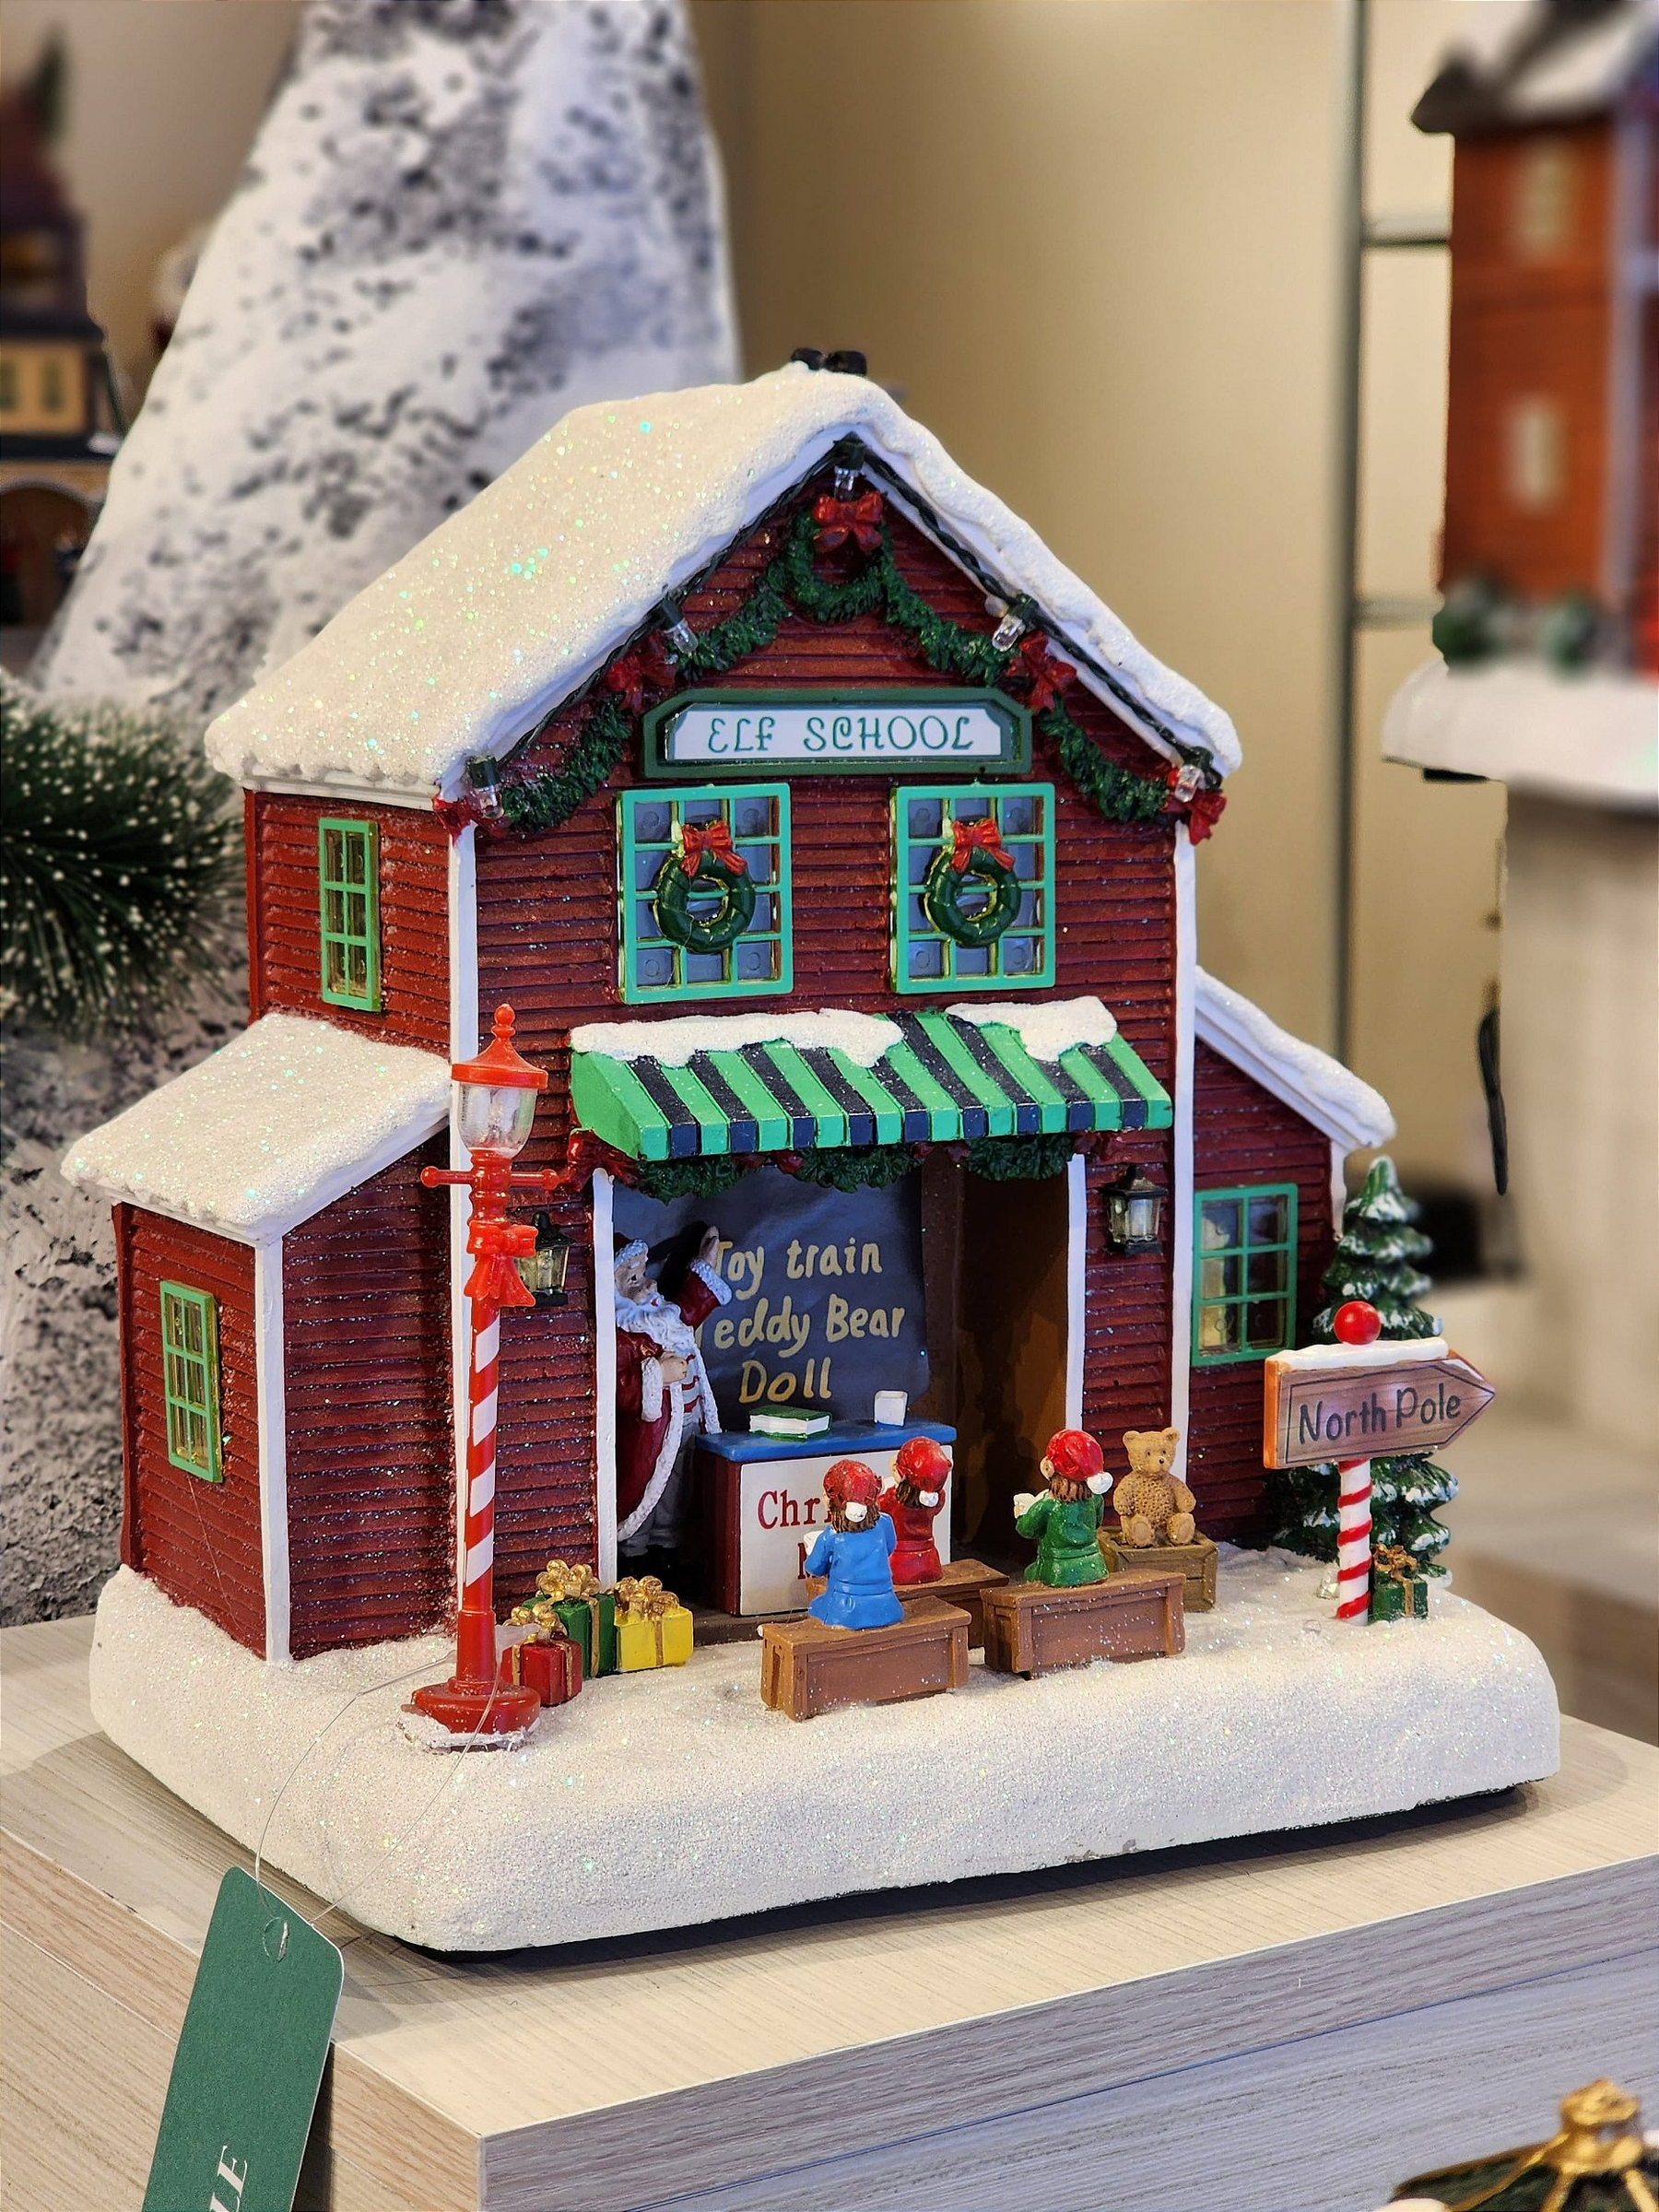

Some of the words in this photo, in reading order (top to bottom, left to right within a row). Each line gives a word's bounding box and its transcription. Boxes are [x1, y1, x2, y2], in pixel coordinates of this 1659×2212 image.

[708, 715, 776, 754] ELF
[803, 714, 974, 752] SCHOOL
[715, 1241, 765, 1300] Toy
[786, 1237, 883, 1279] train
[695, 1295, 811, 1358] eddy
[826, 1293, 905, 1343] Bear
[738, 1357, 832, 1403] Doll
[1299, 1393, 1387, 1445] North
[1395, 1382, 1462, 1429] Pole
